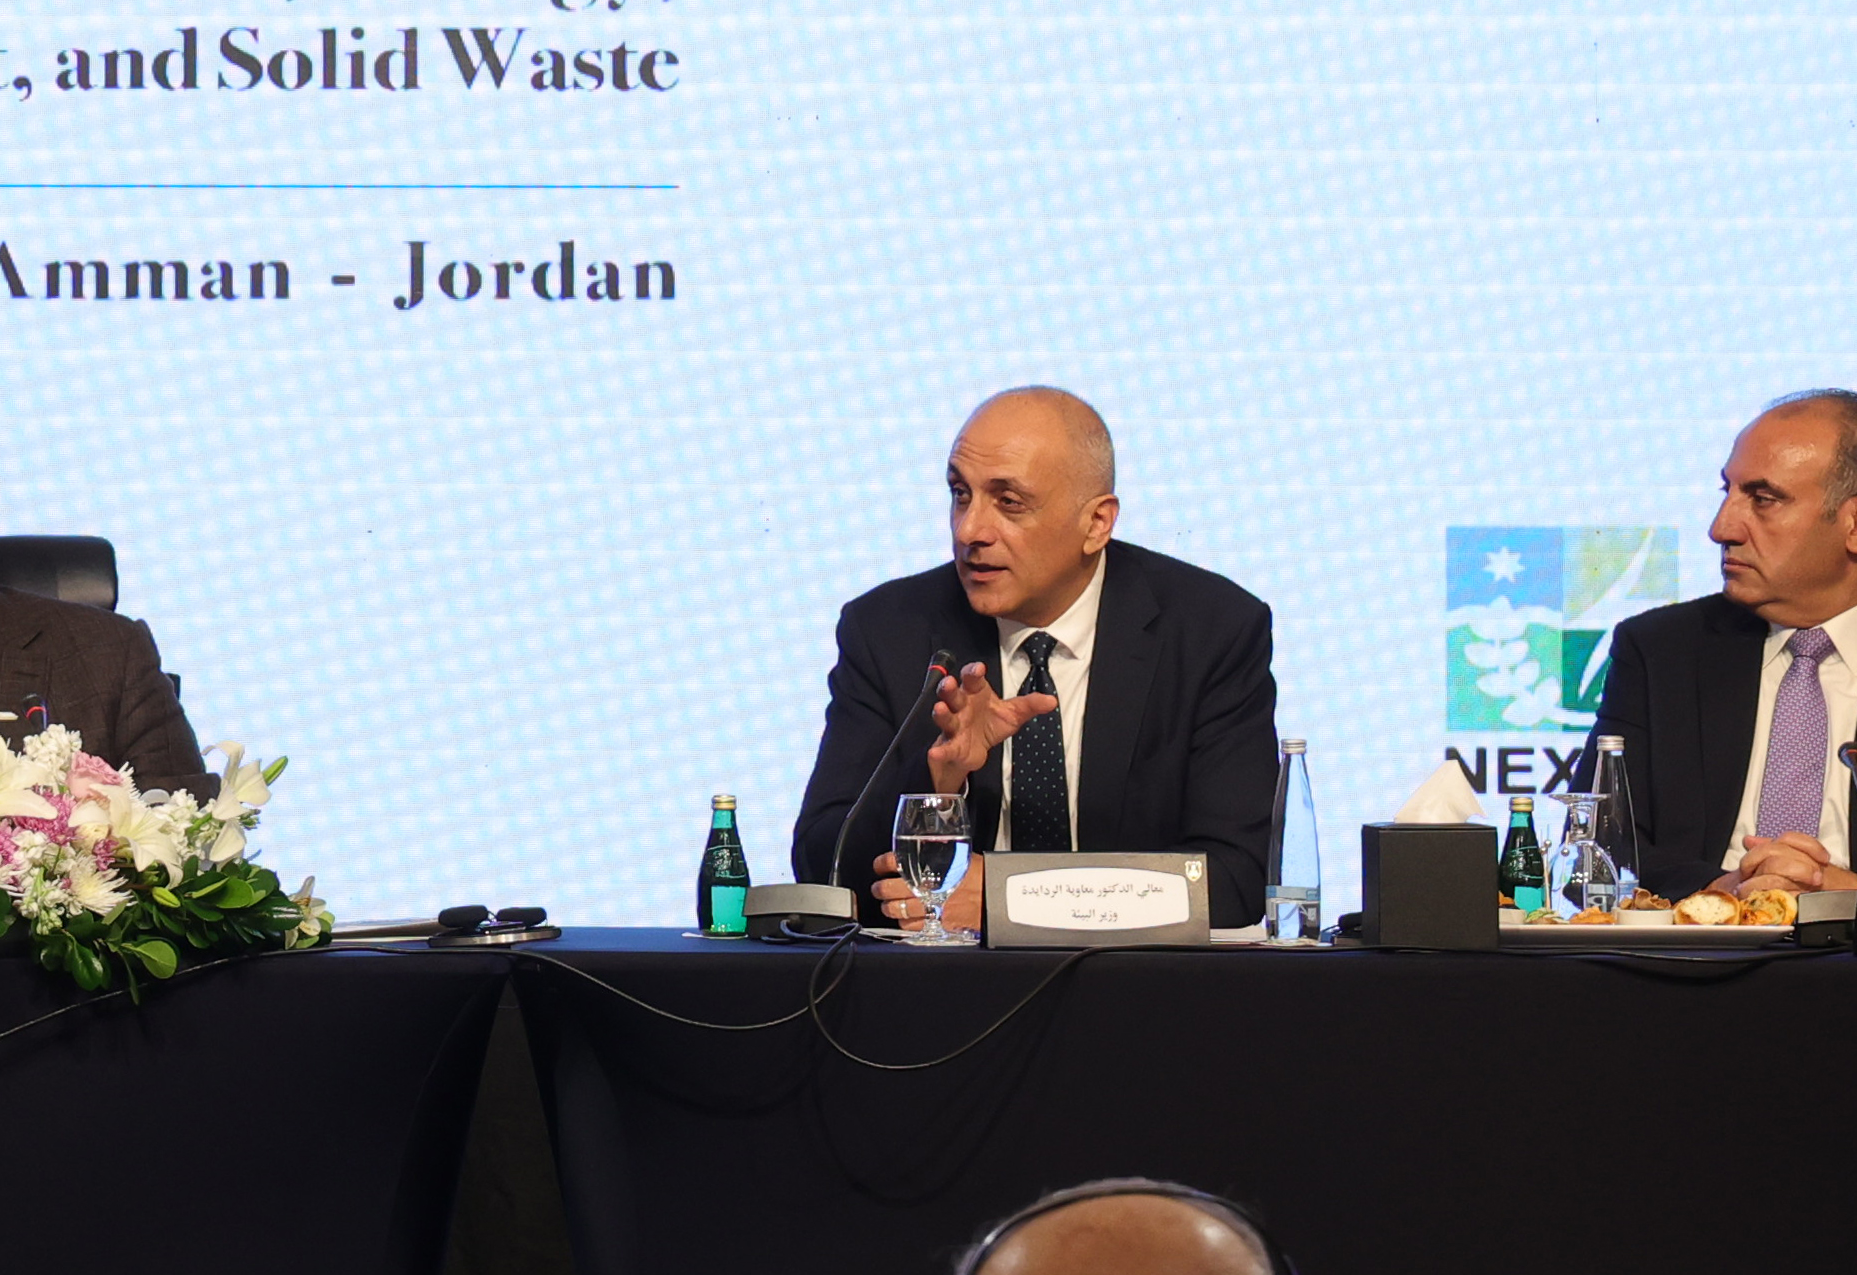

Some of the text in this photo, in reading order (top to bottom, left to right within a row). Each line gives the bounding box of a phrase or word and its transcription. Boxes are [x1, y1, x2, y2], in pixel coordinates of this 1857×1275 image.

[55, 25, 199, 92] and
[216, 26, 420, 92] Solid
[441, 27, 680, 93] Waste
[330, 274, 357, 286] -
[392, 239, 677, 312] Jordan
[1445, 746, 1583, 795] NEX
[1022, 883, 1164, 899] معالي الدكتور معاوية الردايدة
[1071, 908, 1118, 923] وزير البيئة
